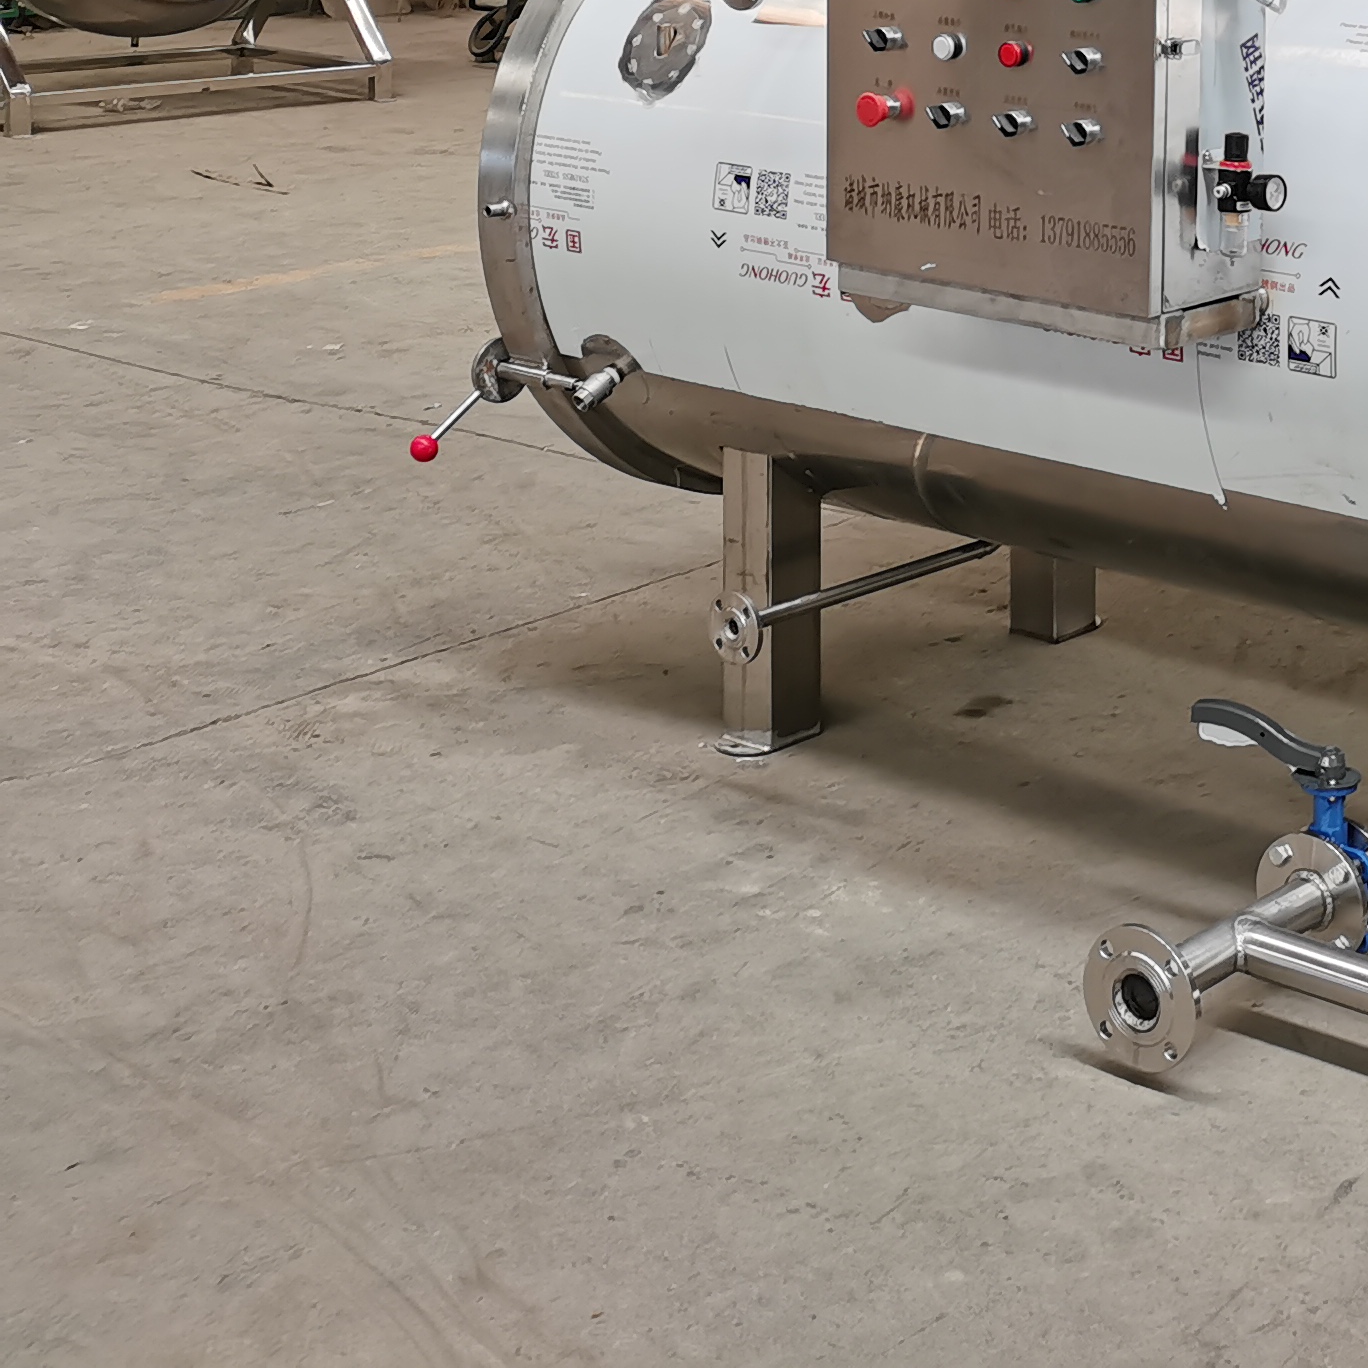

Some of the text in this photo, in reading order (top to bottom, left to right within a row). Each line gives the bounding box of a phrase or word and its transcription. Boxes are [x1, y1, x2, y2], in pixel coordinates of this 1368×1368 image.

[843, 174, 982, 235] 诸城市纳康机械有限公司
[1039, 214, 1136, 258] 13791885556
[542, 225, 582, 254] 国宏
[739, 263, 808, 288] GUOHONG
